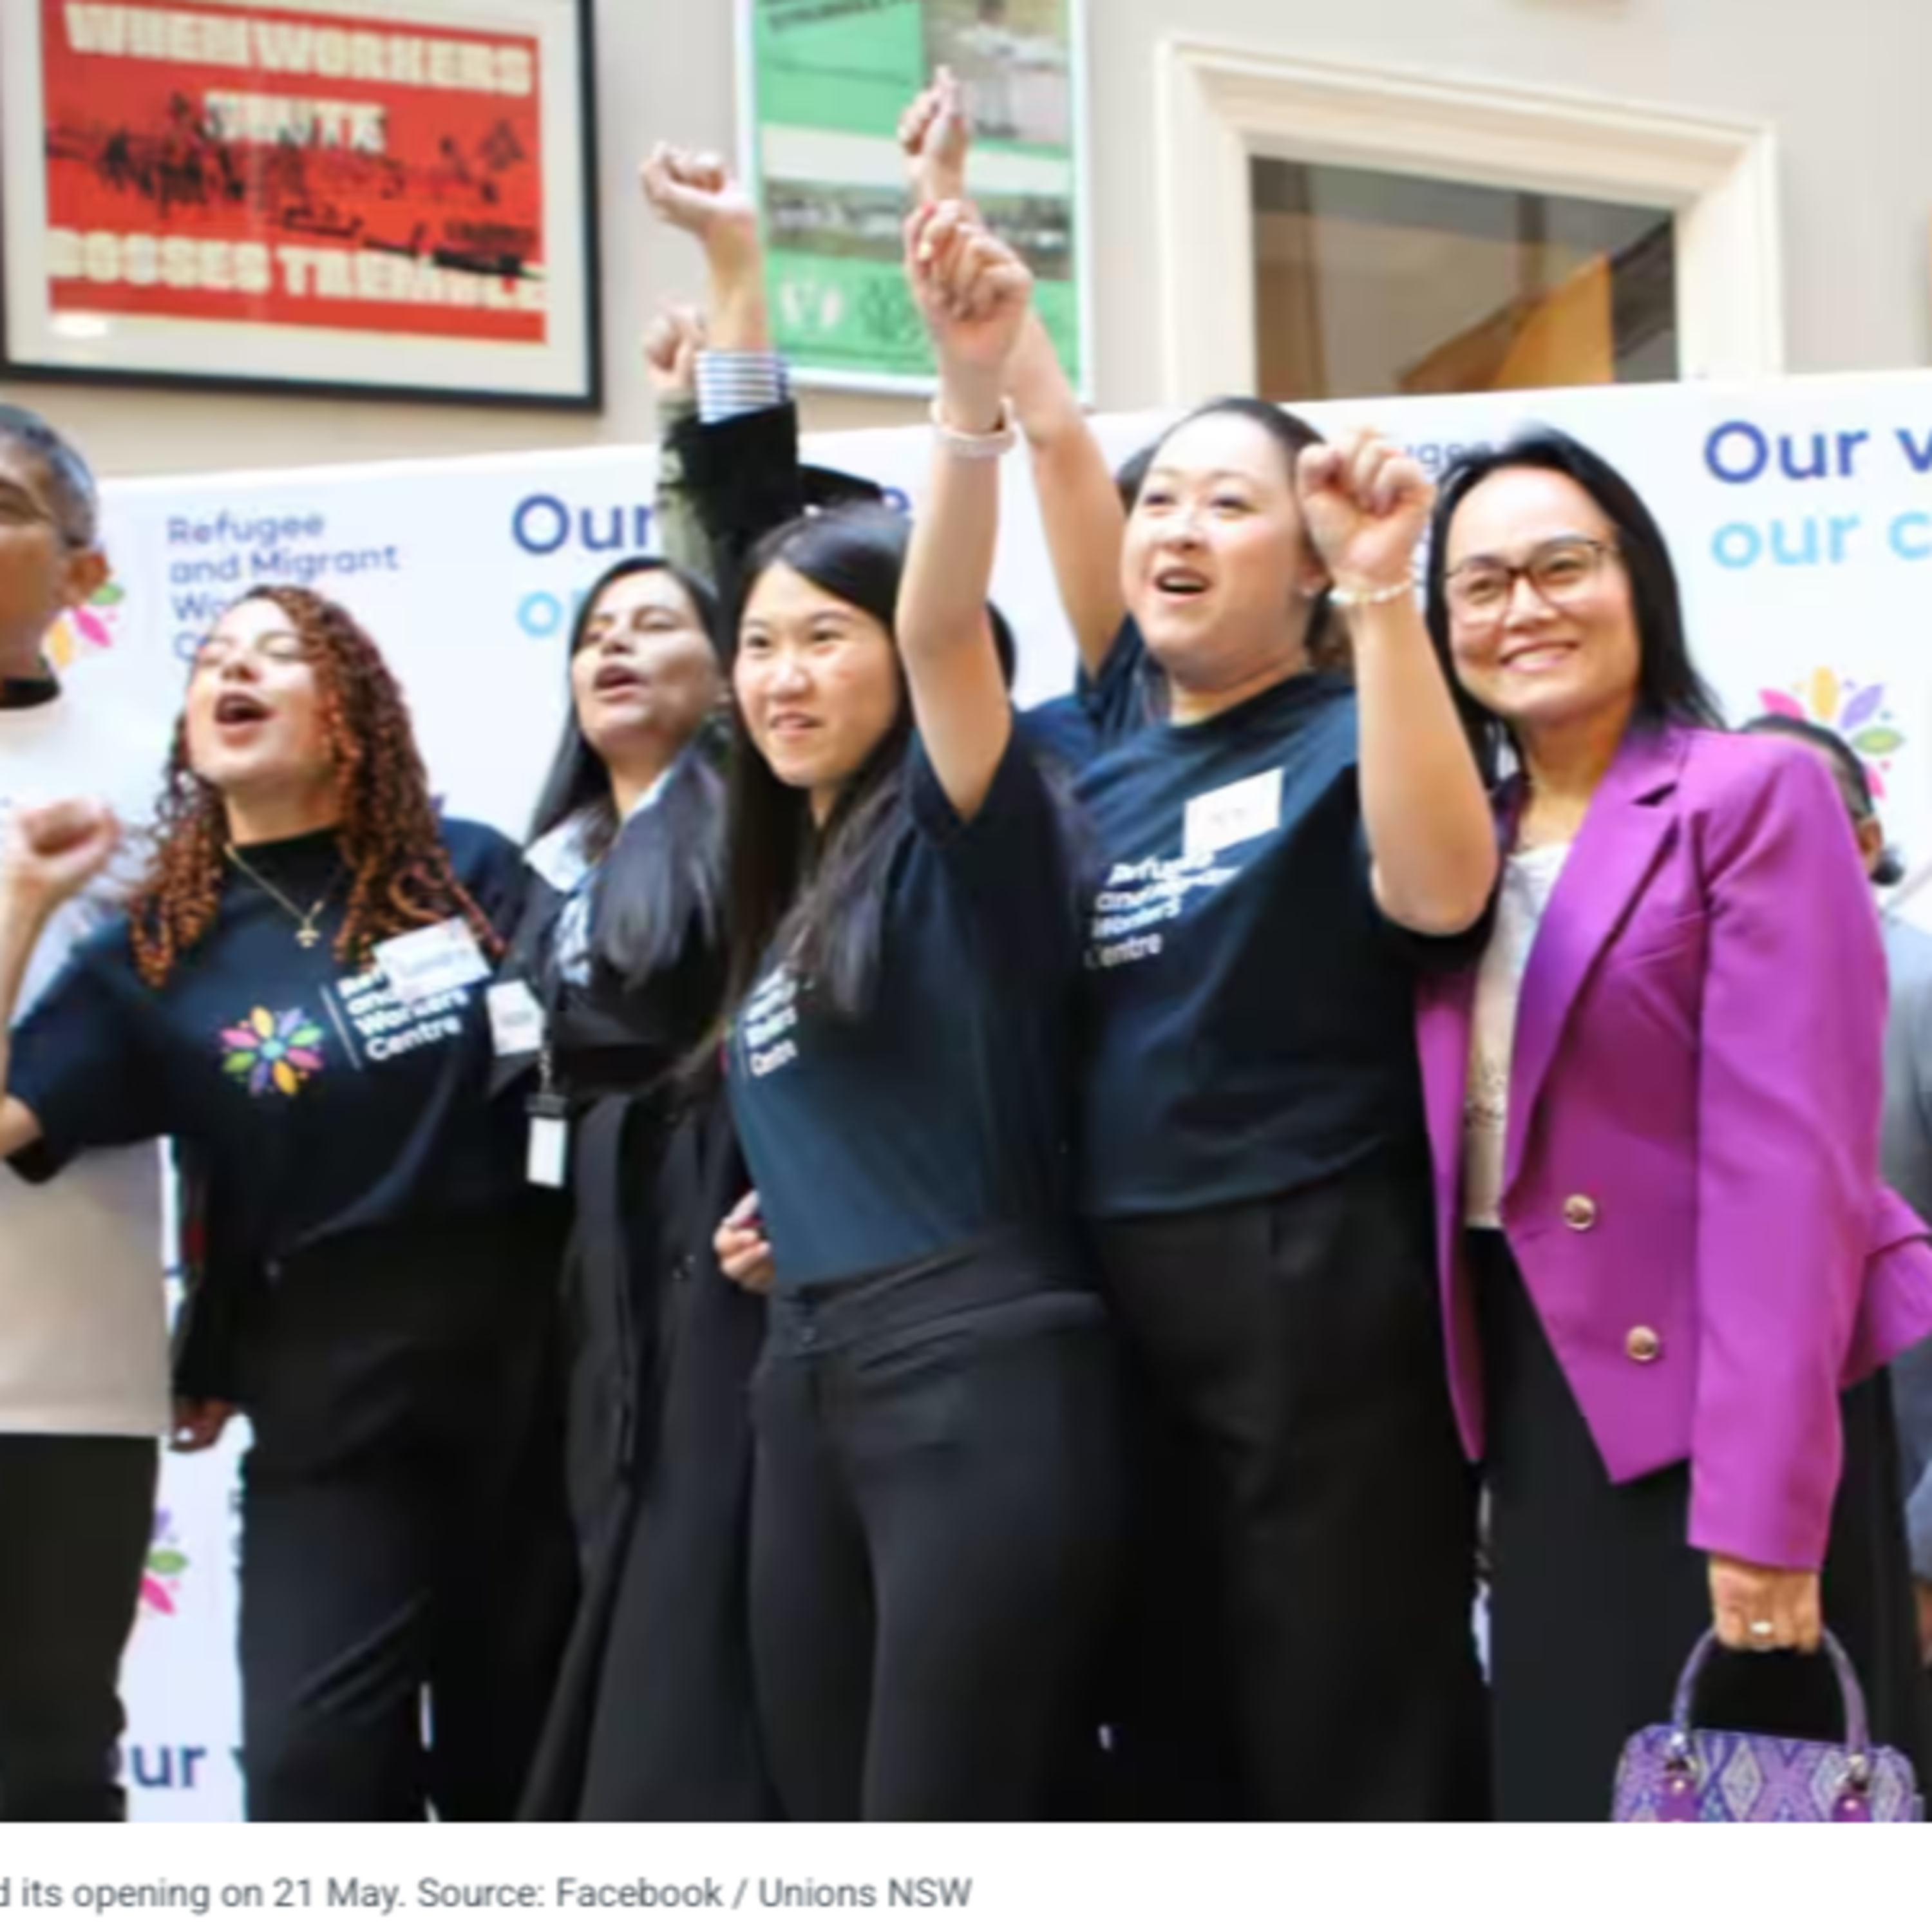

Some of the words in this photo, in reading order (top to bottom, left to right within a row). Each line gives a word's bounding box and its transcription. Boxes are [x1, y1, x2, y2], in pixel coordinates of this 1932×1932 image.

[255, 21, 532, 96] WORKERS
[1703, 420, 1870, 485] Our
[167, 511, 325, 545] Refugee
[1710, 514, 1862, 569] our
[170, 555, 240, 583] and
[250, 545, 400, 582] Migrant
[366, 1015, 462, 1061] Centre
[131, 1747, 207, 1790] ur
